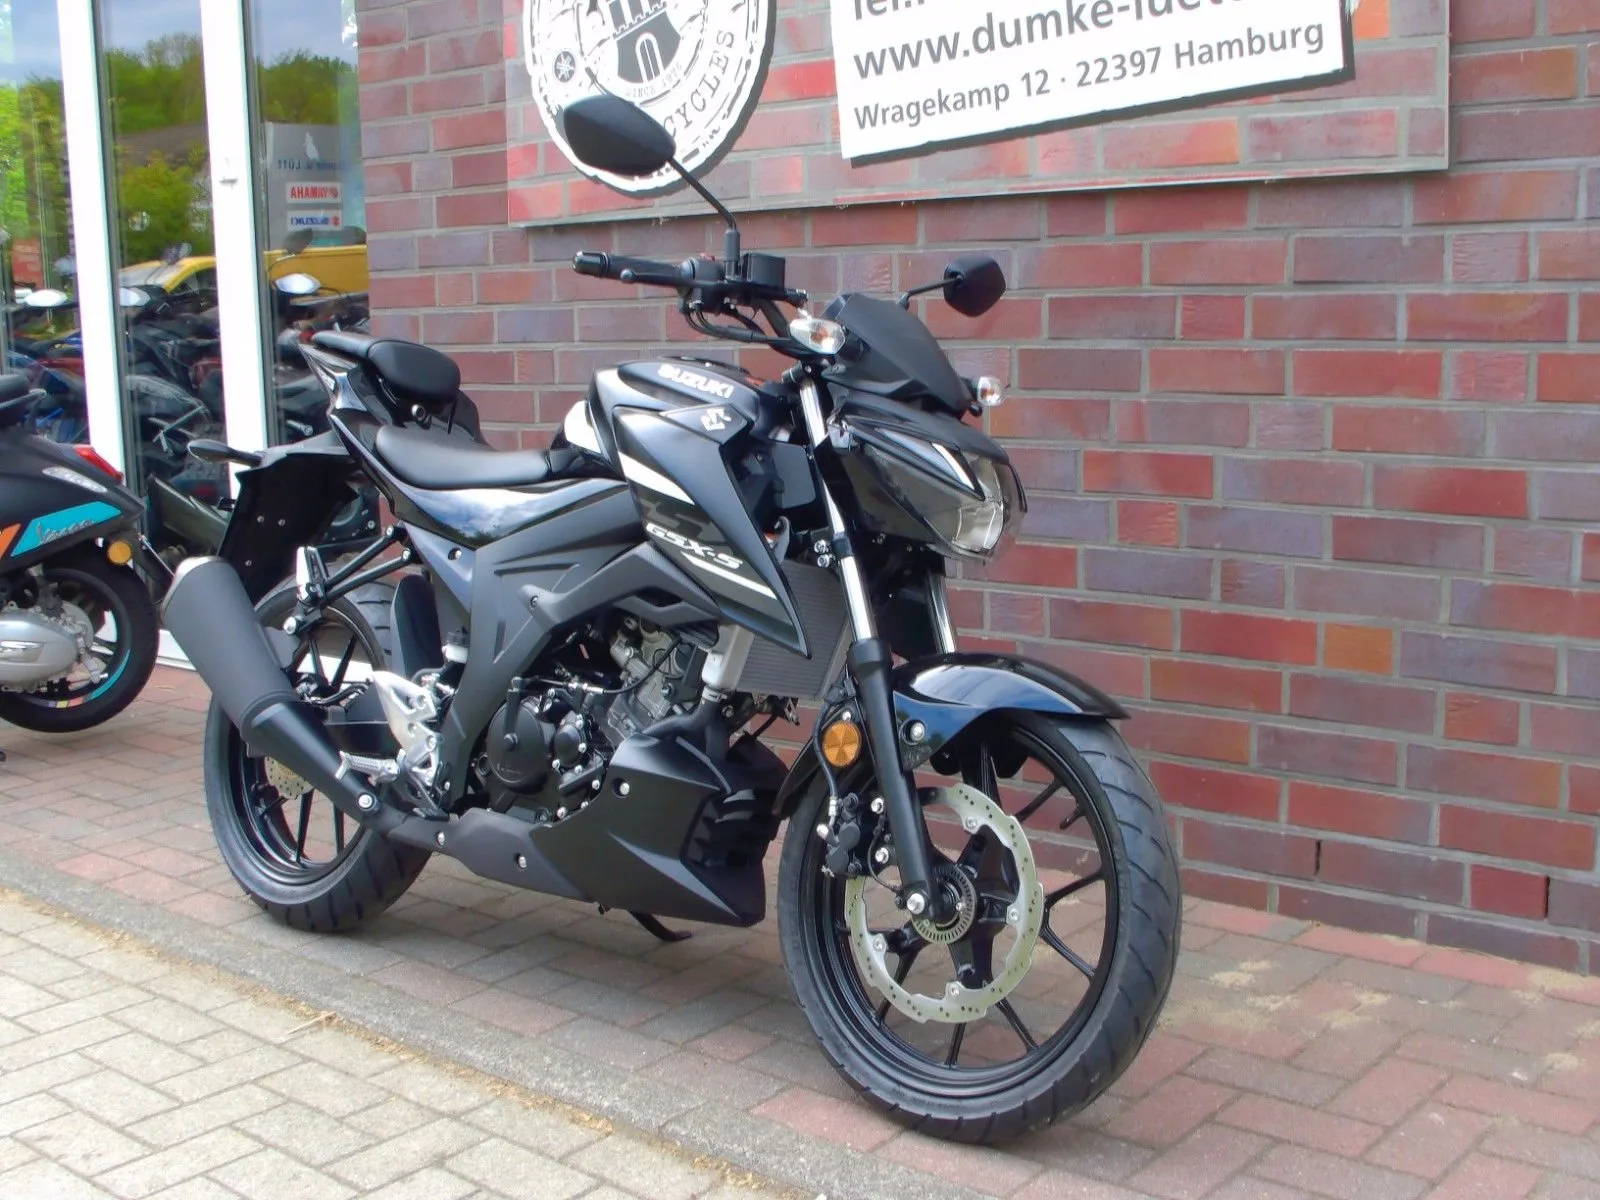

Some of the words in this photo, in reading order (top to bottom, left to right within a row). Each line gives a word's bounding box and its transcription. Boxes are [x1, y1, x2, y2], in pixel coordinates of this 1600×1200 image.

[854, 83, 1010, 130] Wragekamp
[1021, 69, 1050, 97] 12
[1076, 47, 1162, 88] 22397
[1174, 23, 1324, 69] Hamburg
[657, 363, 735, 399] SUZUKI
[646, 522, 744, 571] GSX-S
